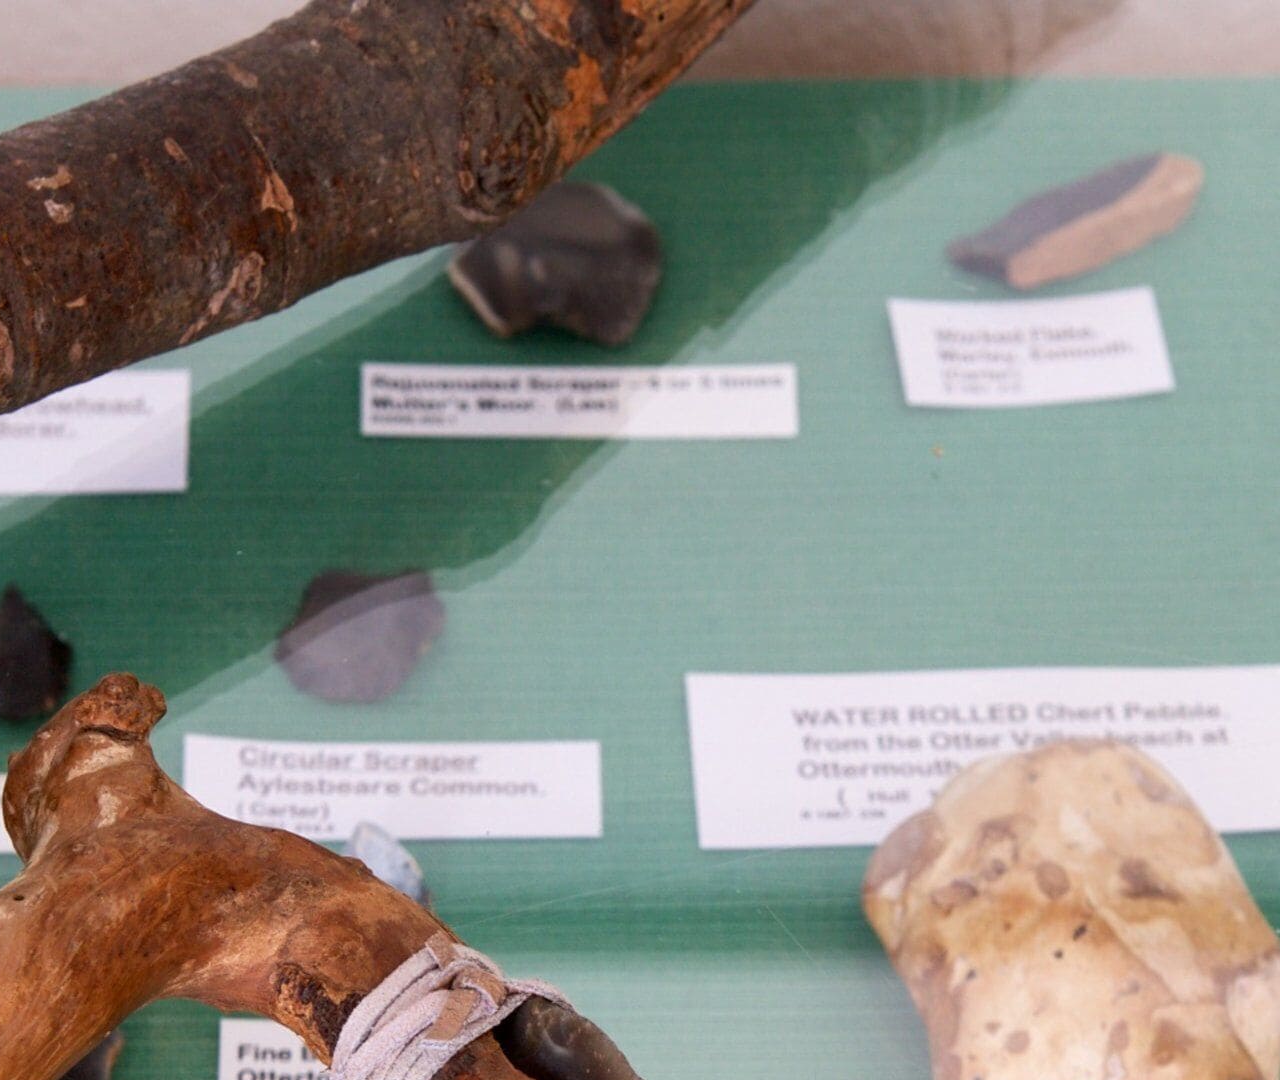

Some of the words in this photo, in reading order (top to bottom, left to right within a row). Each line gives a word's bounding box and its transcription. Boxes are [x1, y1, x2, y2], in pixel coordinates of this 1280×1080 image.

[792, 707, 899, 727] WATER
[908, 703, 1029, 725] ROLLED
[1036, 702, 1115, 723] Chert
[802, 734, 869, 752] from
[876, 734, 922, 752] the
[929, 732, 1002, 750] Otter
[1201, 727, 1229, 745] at
[237, 744, 356, 771] Circular
[362, 747, 480, 775] Scraper
[237, 772, 400, 797] Aylesbeare
[409, 777, 547, 797] Common.
[238, 1043, 292, 1061] Fine
